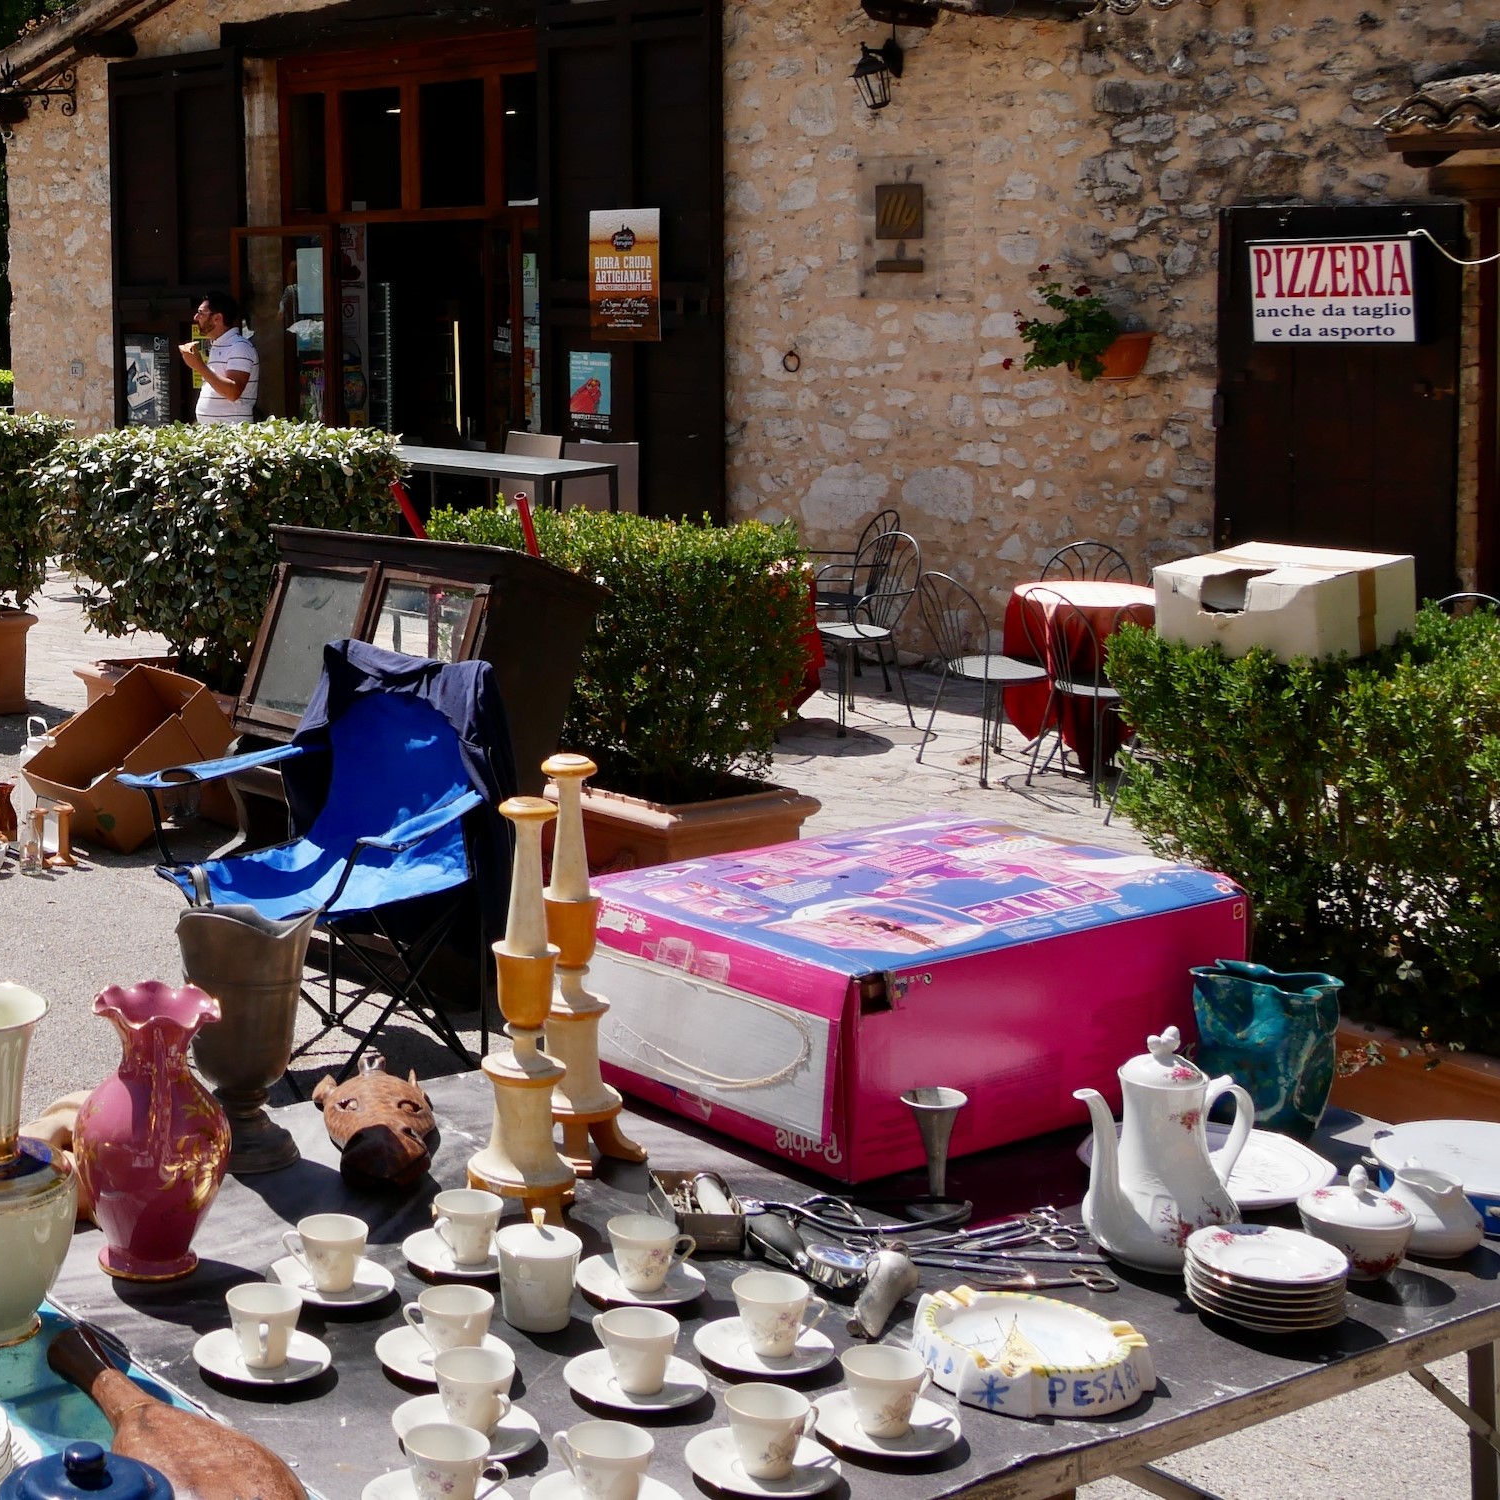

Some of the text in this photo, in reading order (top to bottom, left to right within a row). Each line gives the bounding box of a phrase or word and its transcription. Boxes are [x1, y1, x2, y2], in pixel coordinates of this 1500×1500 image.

[594, 255, 652, 270] BIRRA CRUDA
[595, 270, 652, 283] ARTIGIANALE
[1253, 244, 1411, 298] PIZZERIA
[1256, 303, 1411, 319] anche da taglio
[1272, 324, 1395, 339] e da asporto
[775, 1128, 842, 1164] Barbie
